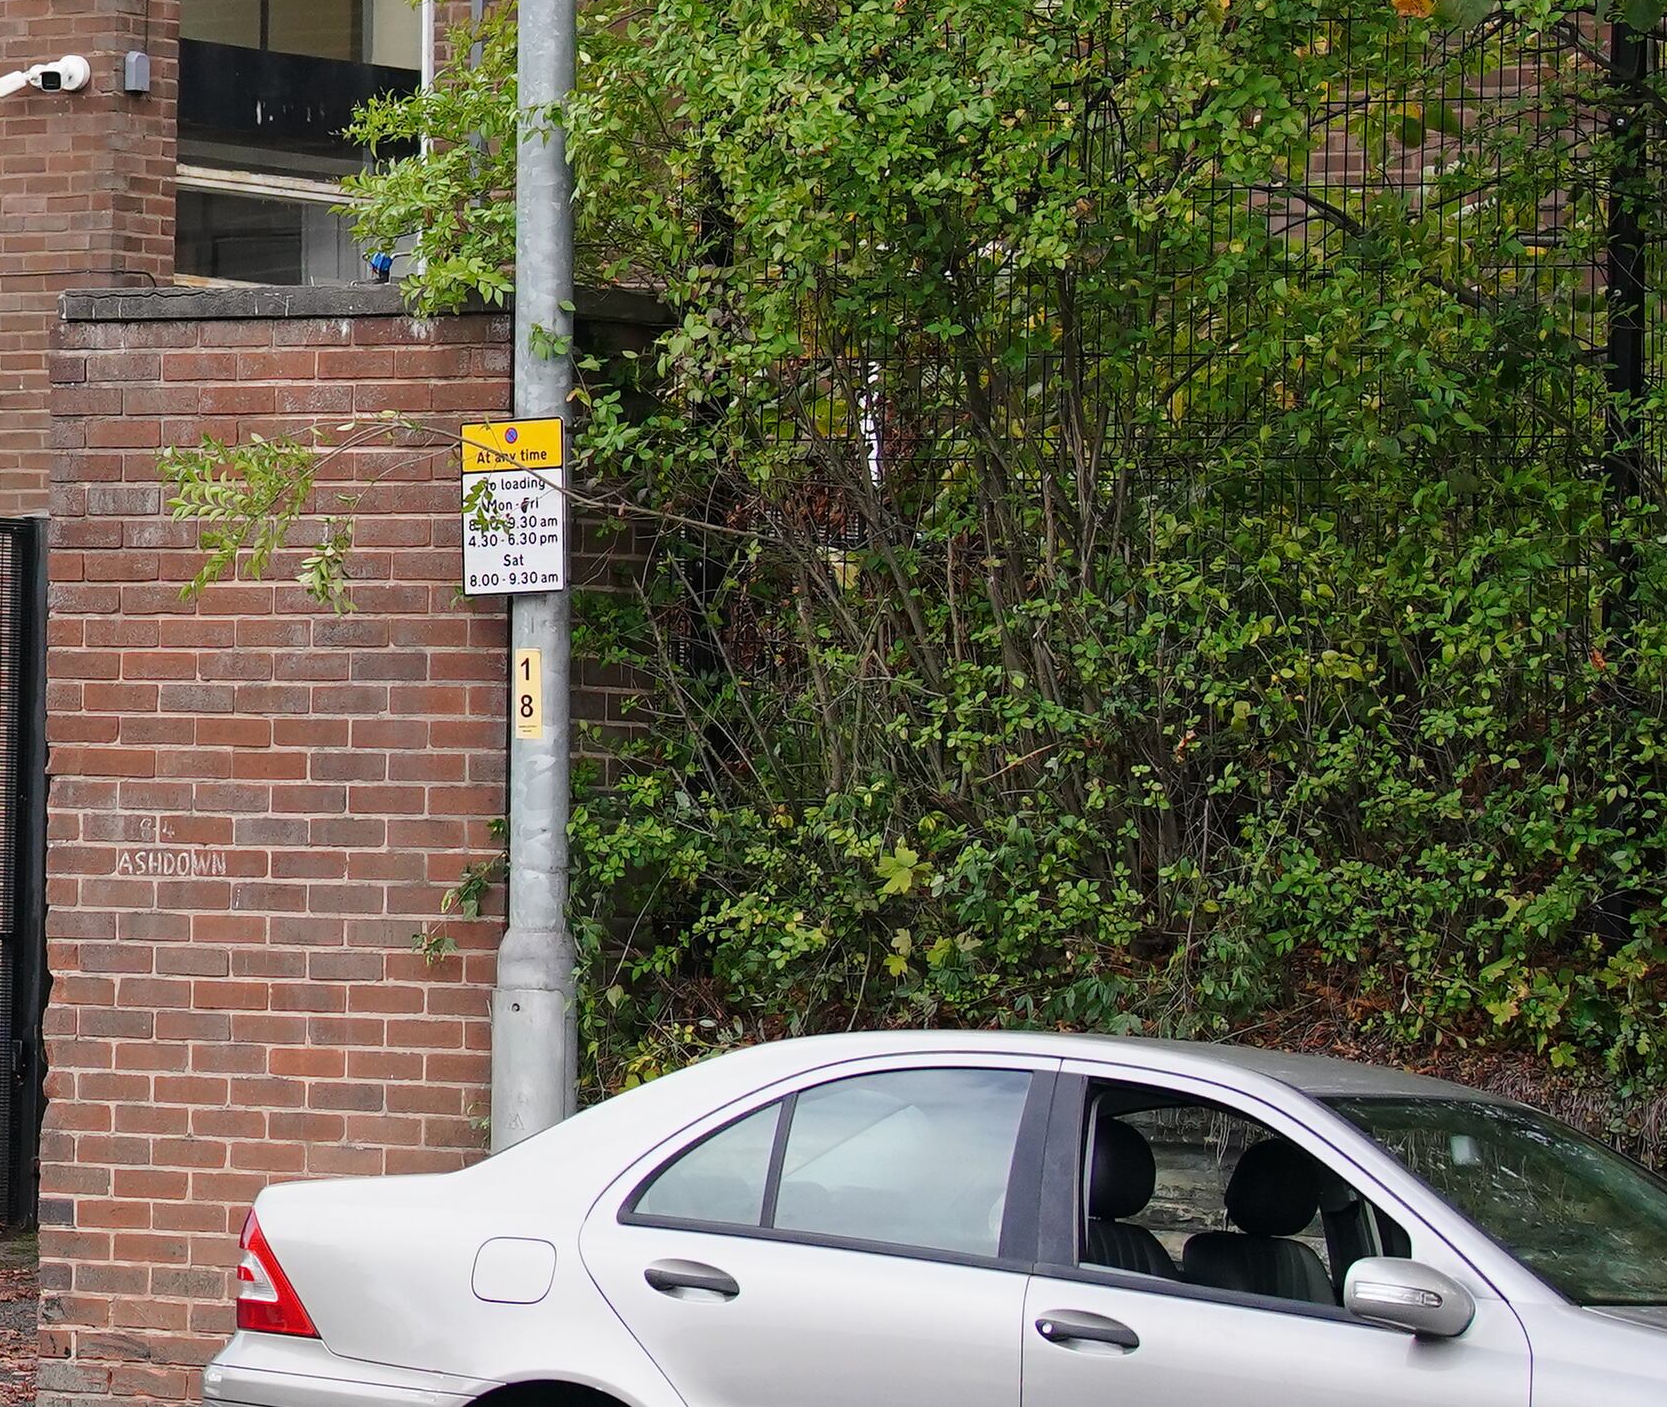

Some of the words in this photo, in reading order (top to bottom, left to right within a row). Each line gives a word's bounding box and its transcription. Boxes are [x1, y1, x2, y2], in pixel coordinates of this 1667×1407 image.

[477, 452, 490, 464] At
[495, 453, 516, 465] any
[520, 449, 547, 461] time
[501, 477, 545, 491] loading
[487, 499, 513, 511] Mon
[508, 515, 537, 529] 9.30
[540, 517, 558, 527] am
[468, 534, 498, 548] 4.30
[508, 532, 537, 546] 6.30
[540, 533, 558, 546] pm
[503, 554, 524, 567] Sat
[470, 573, 499, 587] 8.00
[509, 571, 538, 585] 9.30
[541, 573, 558, 584] am
[118, 851, 227, 875] ASHDOWN
